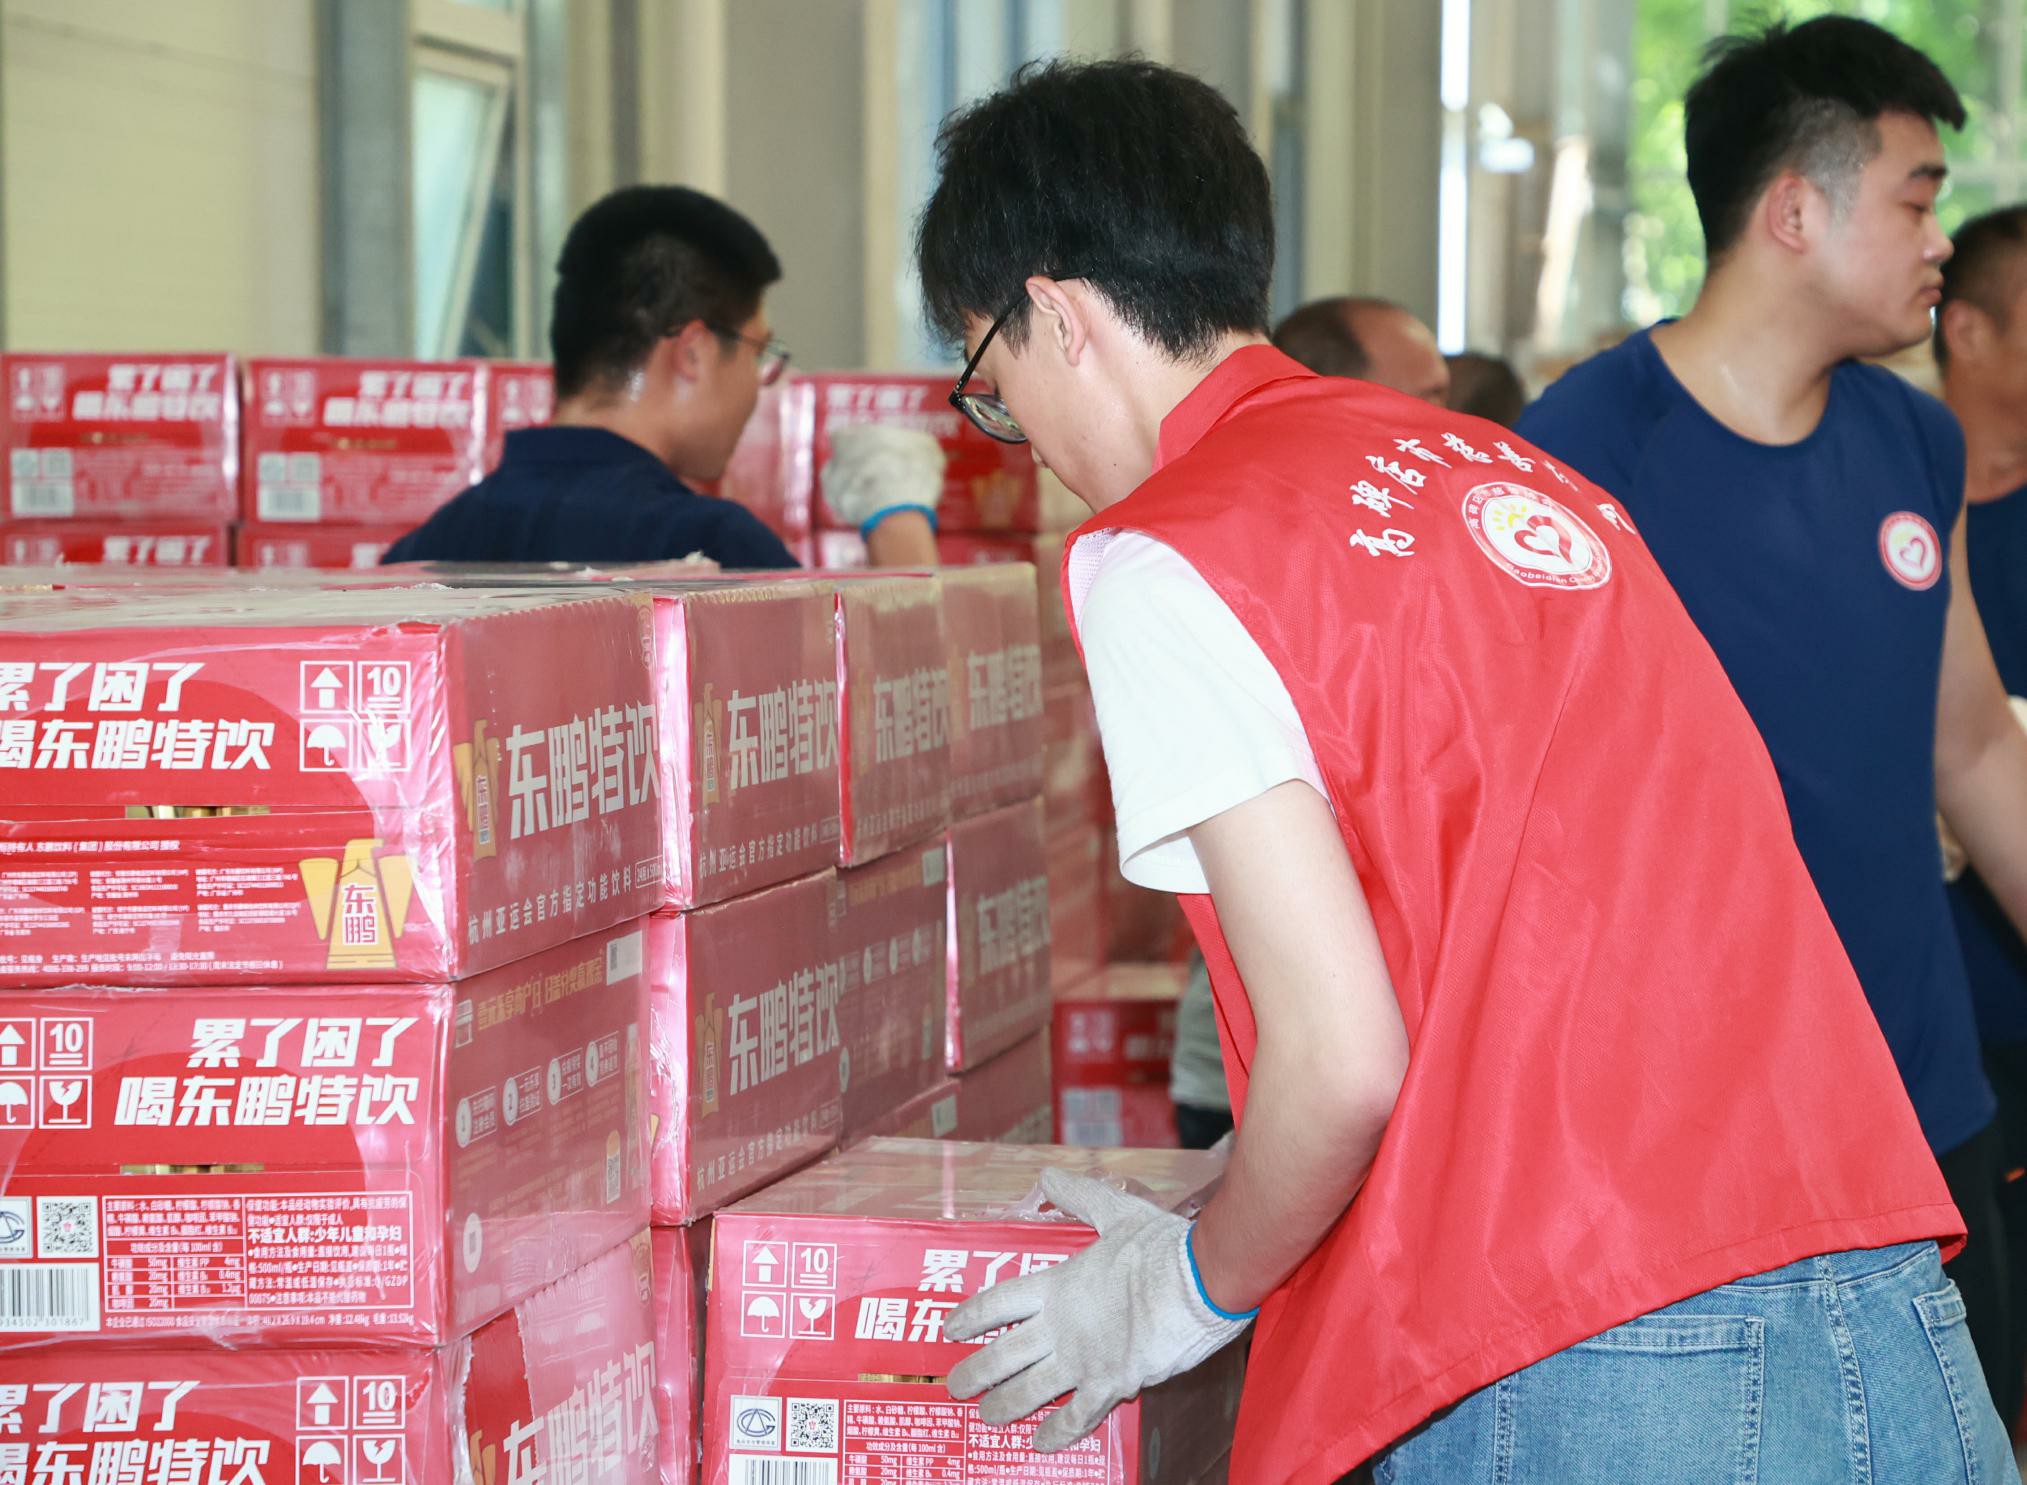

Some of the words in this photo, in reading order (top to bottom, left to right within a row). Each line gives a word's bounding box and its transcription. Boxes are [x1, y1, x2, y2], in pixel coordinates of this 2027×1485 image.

[728, 678, 839, 790] 东鹏特饮
[506, 701, 661, 840] 东鹏特饮
[343, 884, 379, 945] 东鹏
[186, 1017, 420, 1068] 累了困了
[728, 963, 840, 1096] 东鹏特饮
[114, 1075, 420, 1127] 喝东鹏特饮
[248, 1226, 402, 1244] 不适宜人群:少年儿童和孕妇
[800, 1247, 829, 1274] 10
[503, 1340, 660, 1485] 东鹏特饮
